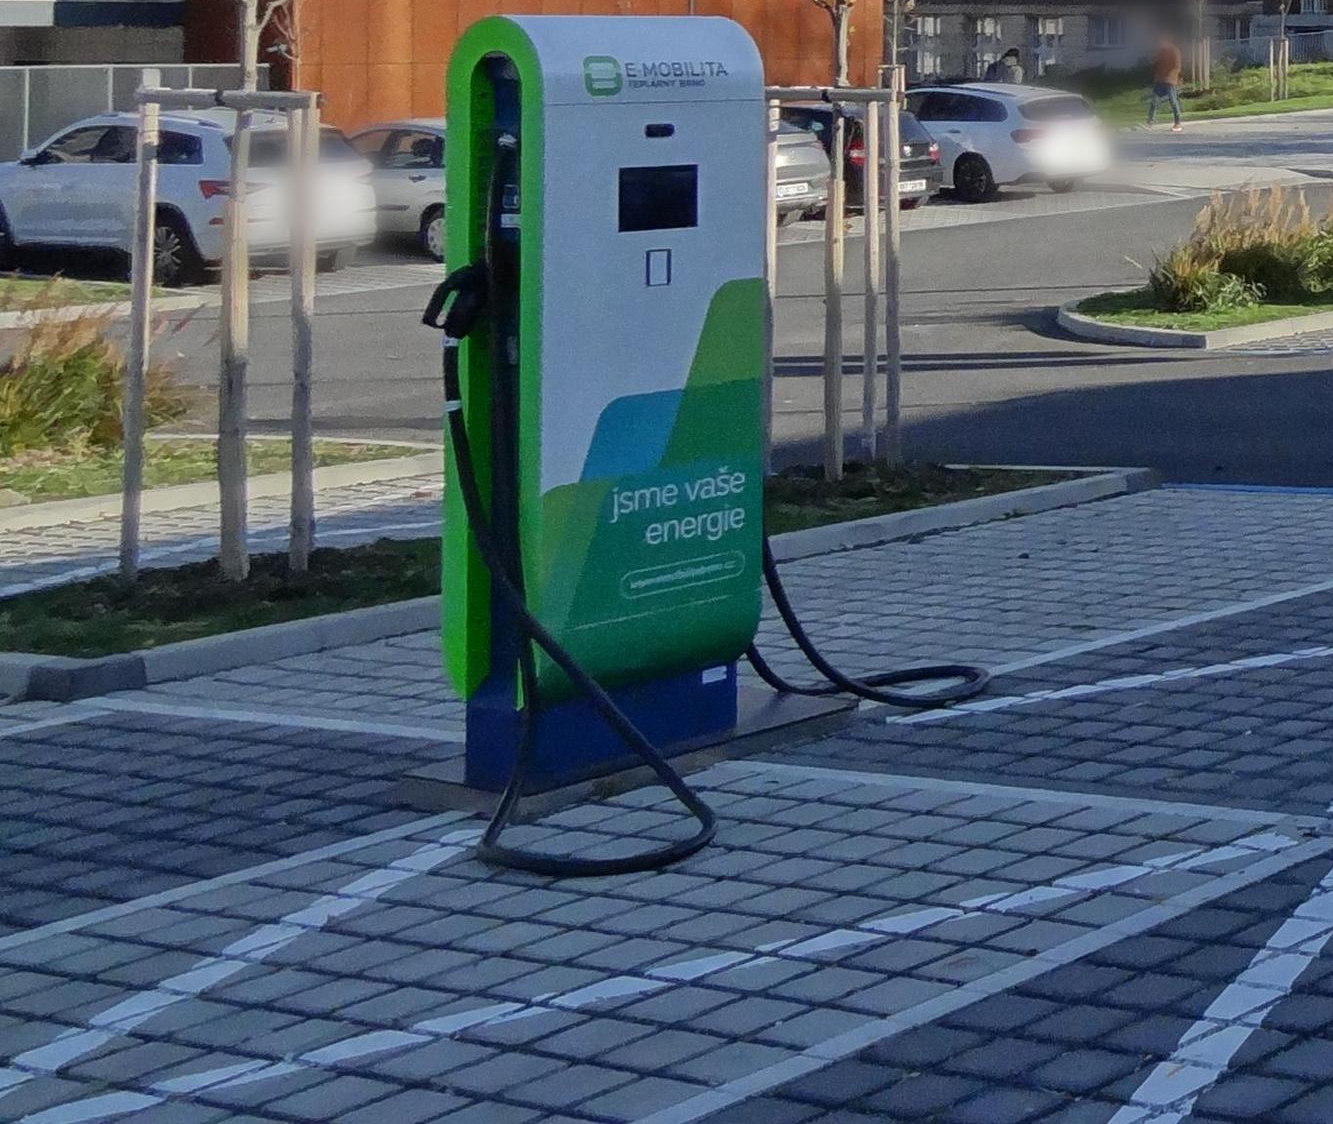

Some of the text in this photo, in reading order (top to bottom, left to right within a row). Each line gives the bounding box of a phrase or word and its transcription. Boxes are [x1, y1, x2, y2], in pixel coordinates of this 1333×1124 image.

[610, 465, 746, 524] jsme vaše
[645, 504, 746, 545] energie
